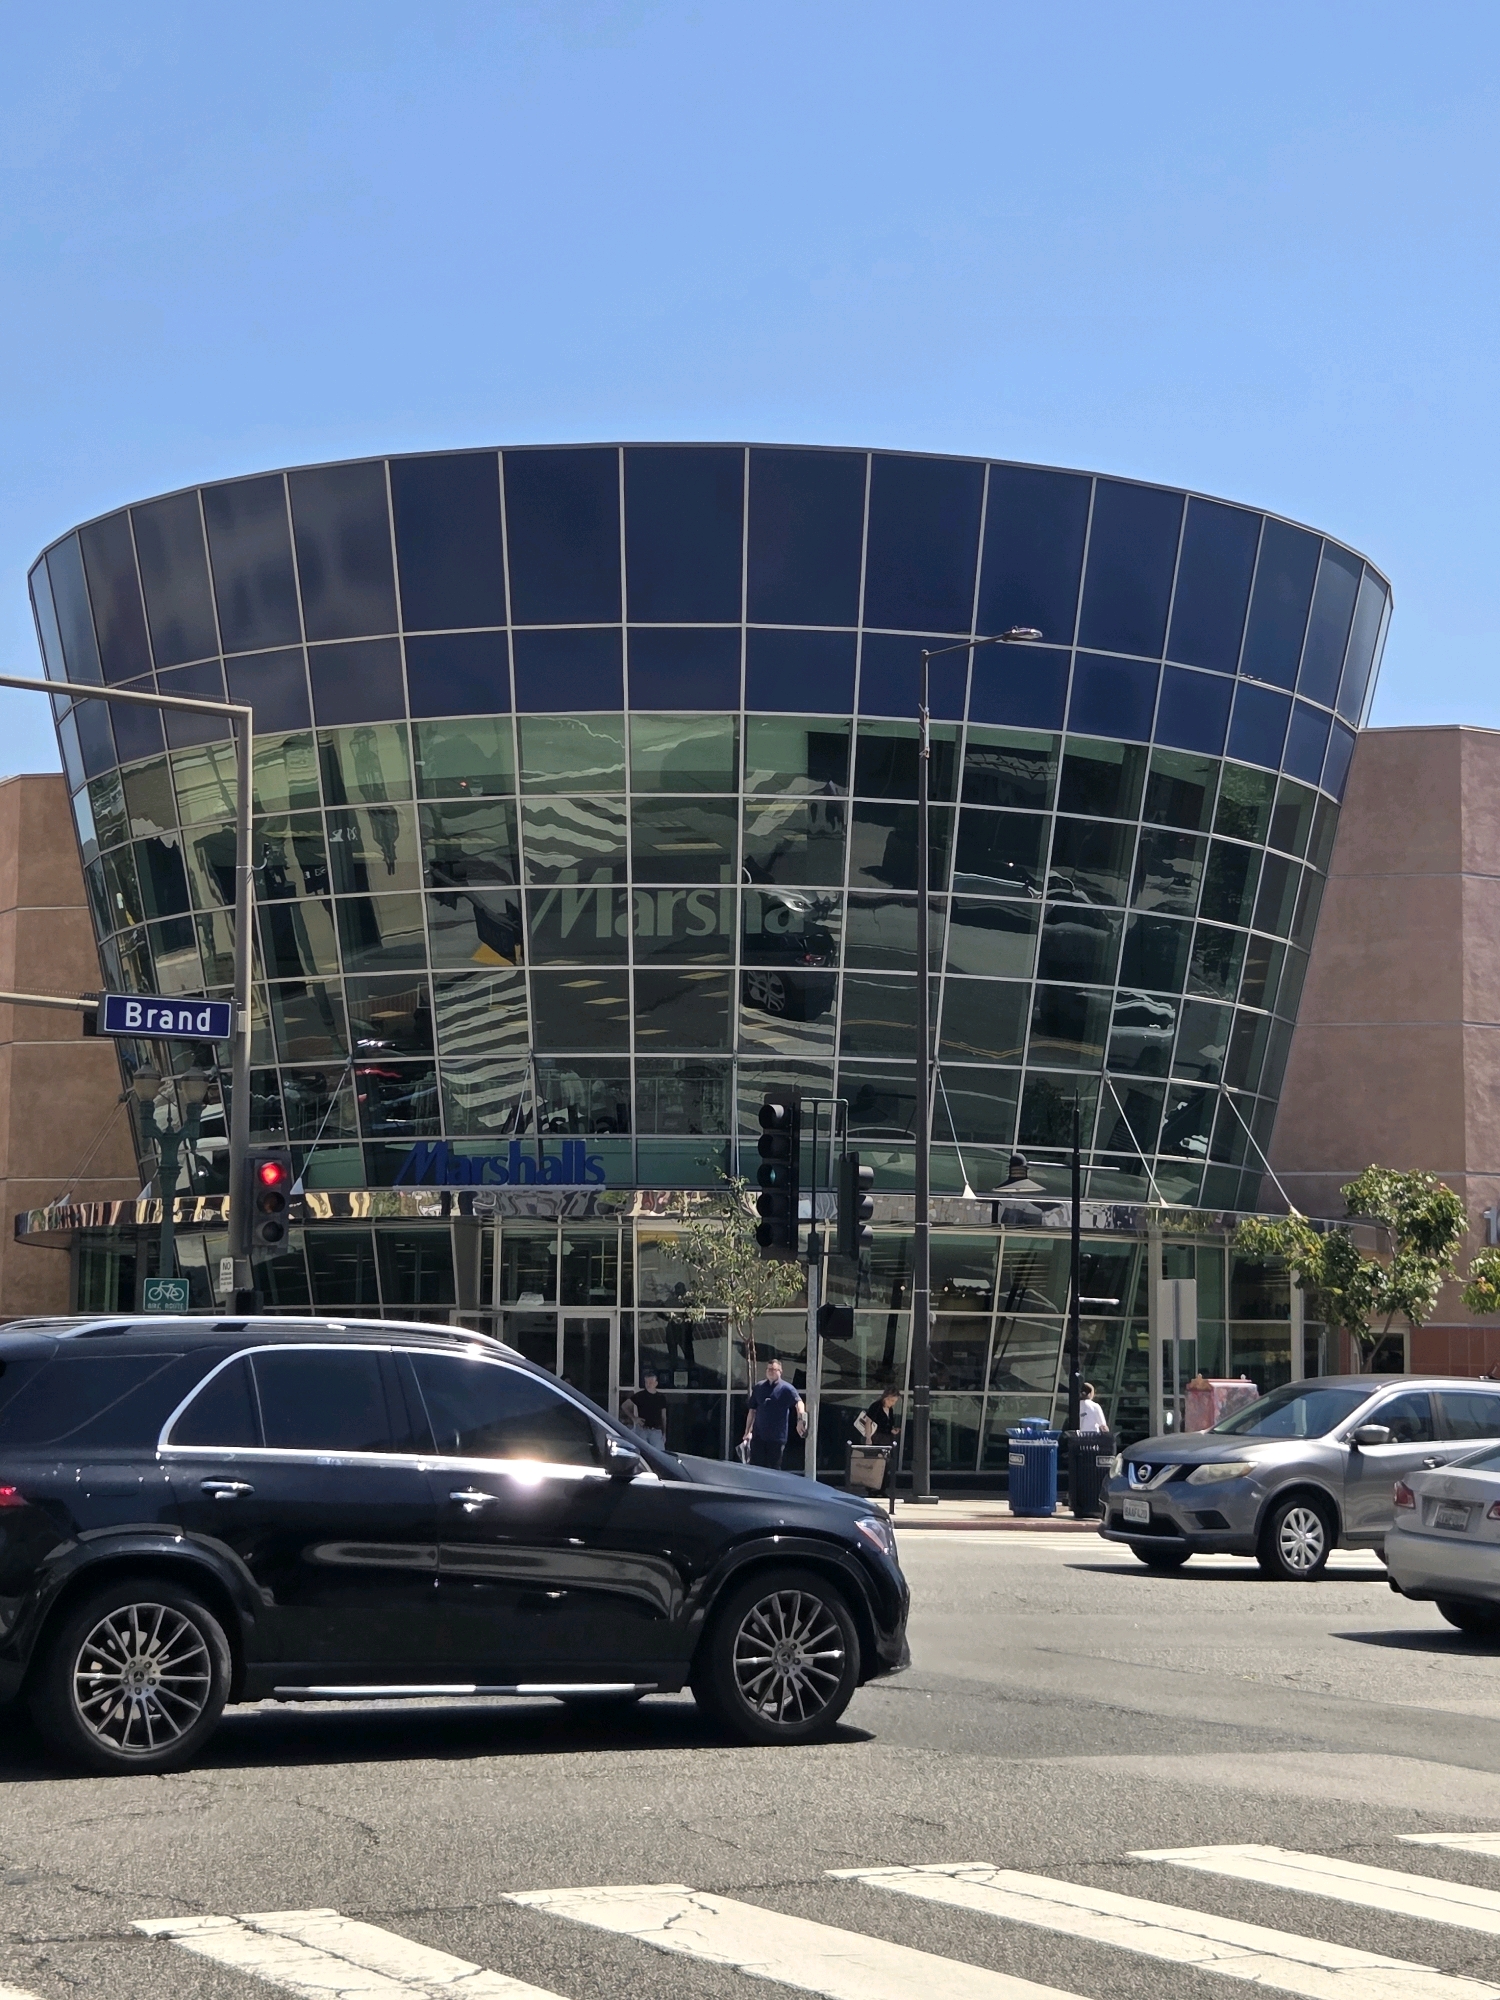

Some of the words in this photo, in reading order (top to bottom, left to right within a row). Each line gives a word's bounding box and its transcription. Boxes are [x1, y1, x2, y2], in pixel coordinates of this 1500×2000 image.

[531, 864, 805, 939] Marsha
[125, 1001, 211, 1032] Brand
[393, 1140, 606, 1186] Marshalls
[1483, 1206, 1499, 1245] 1
[222, 1262, 231, 1270] NO
